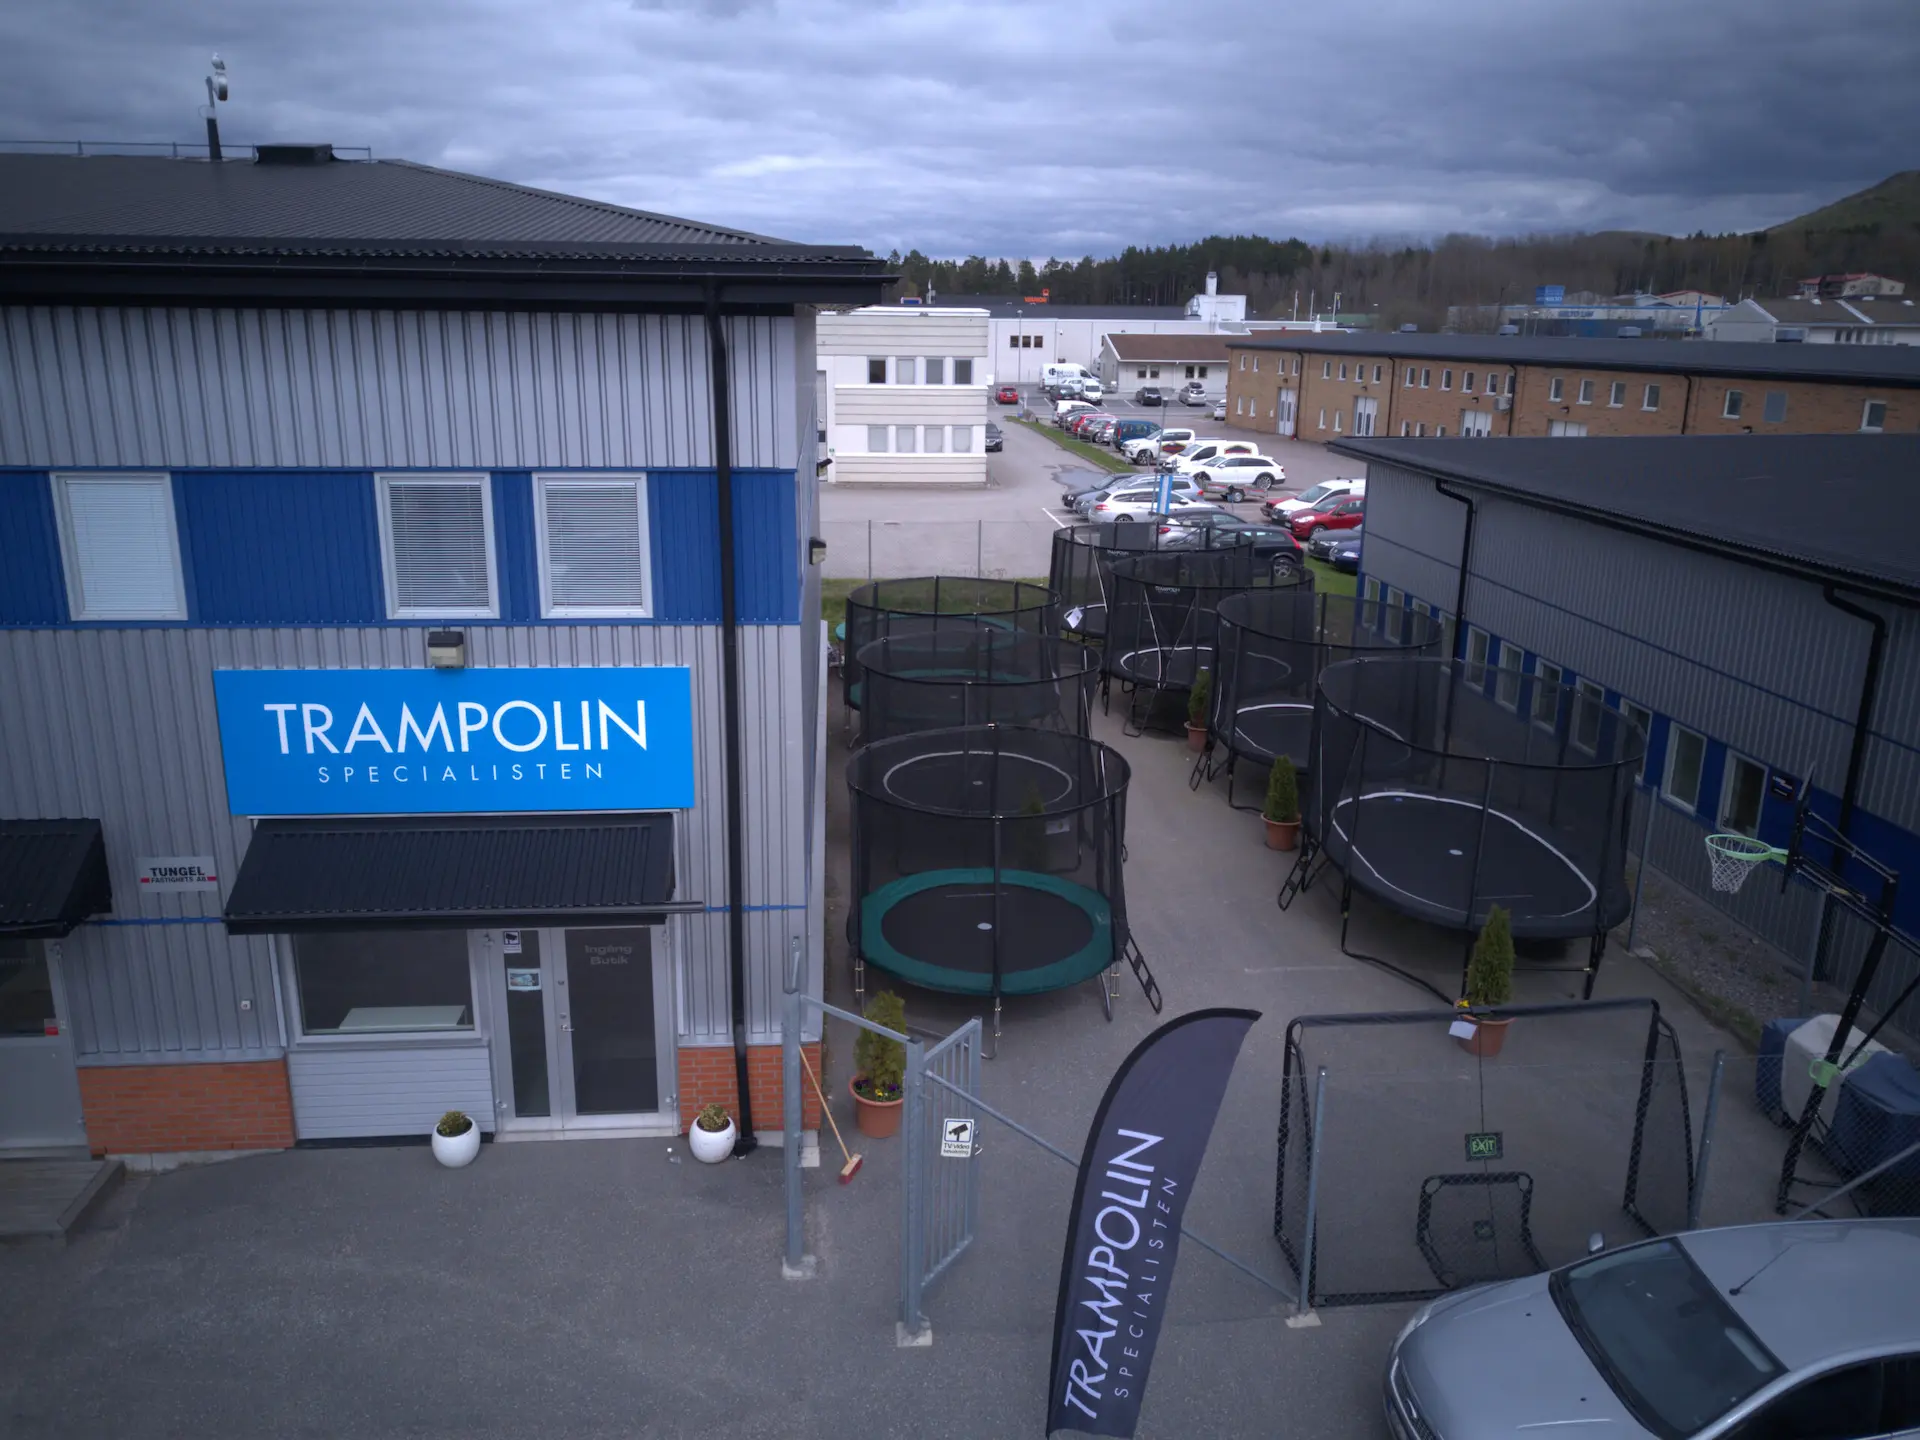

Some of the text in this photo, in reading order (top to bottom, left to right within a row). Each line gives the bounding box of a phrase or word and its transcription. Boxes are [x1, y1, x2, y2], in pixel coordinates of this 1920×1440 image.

[264, 699, 647, 755] TRAMPOLIN
[318, 763, 604, 784] SPECIALISTEN
[149, 866, 204, 876] TUNGEL
[1472, 1138, 1495, 1154] EXIT
[1064, 1128, 1165, 1419] TRAMPOLIN
[1115, 1177, 1179, 1398] SPECIALISTEN
